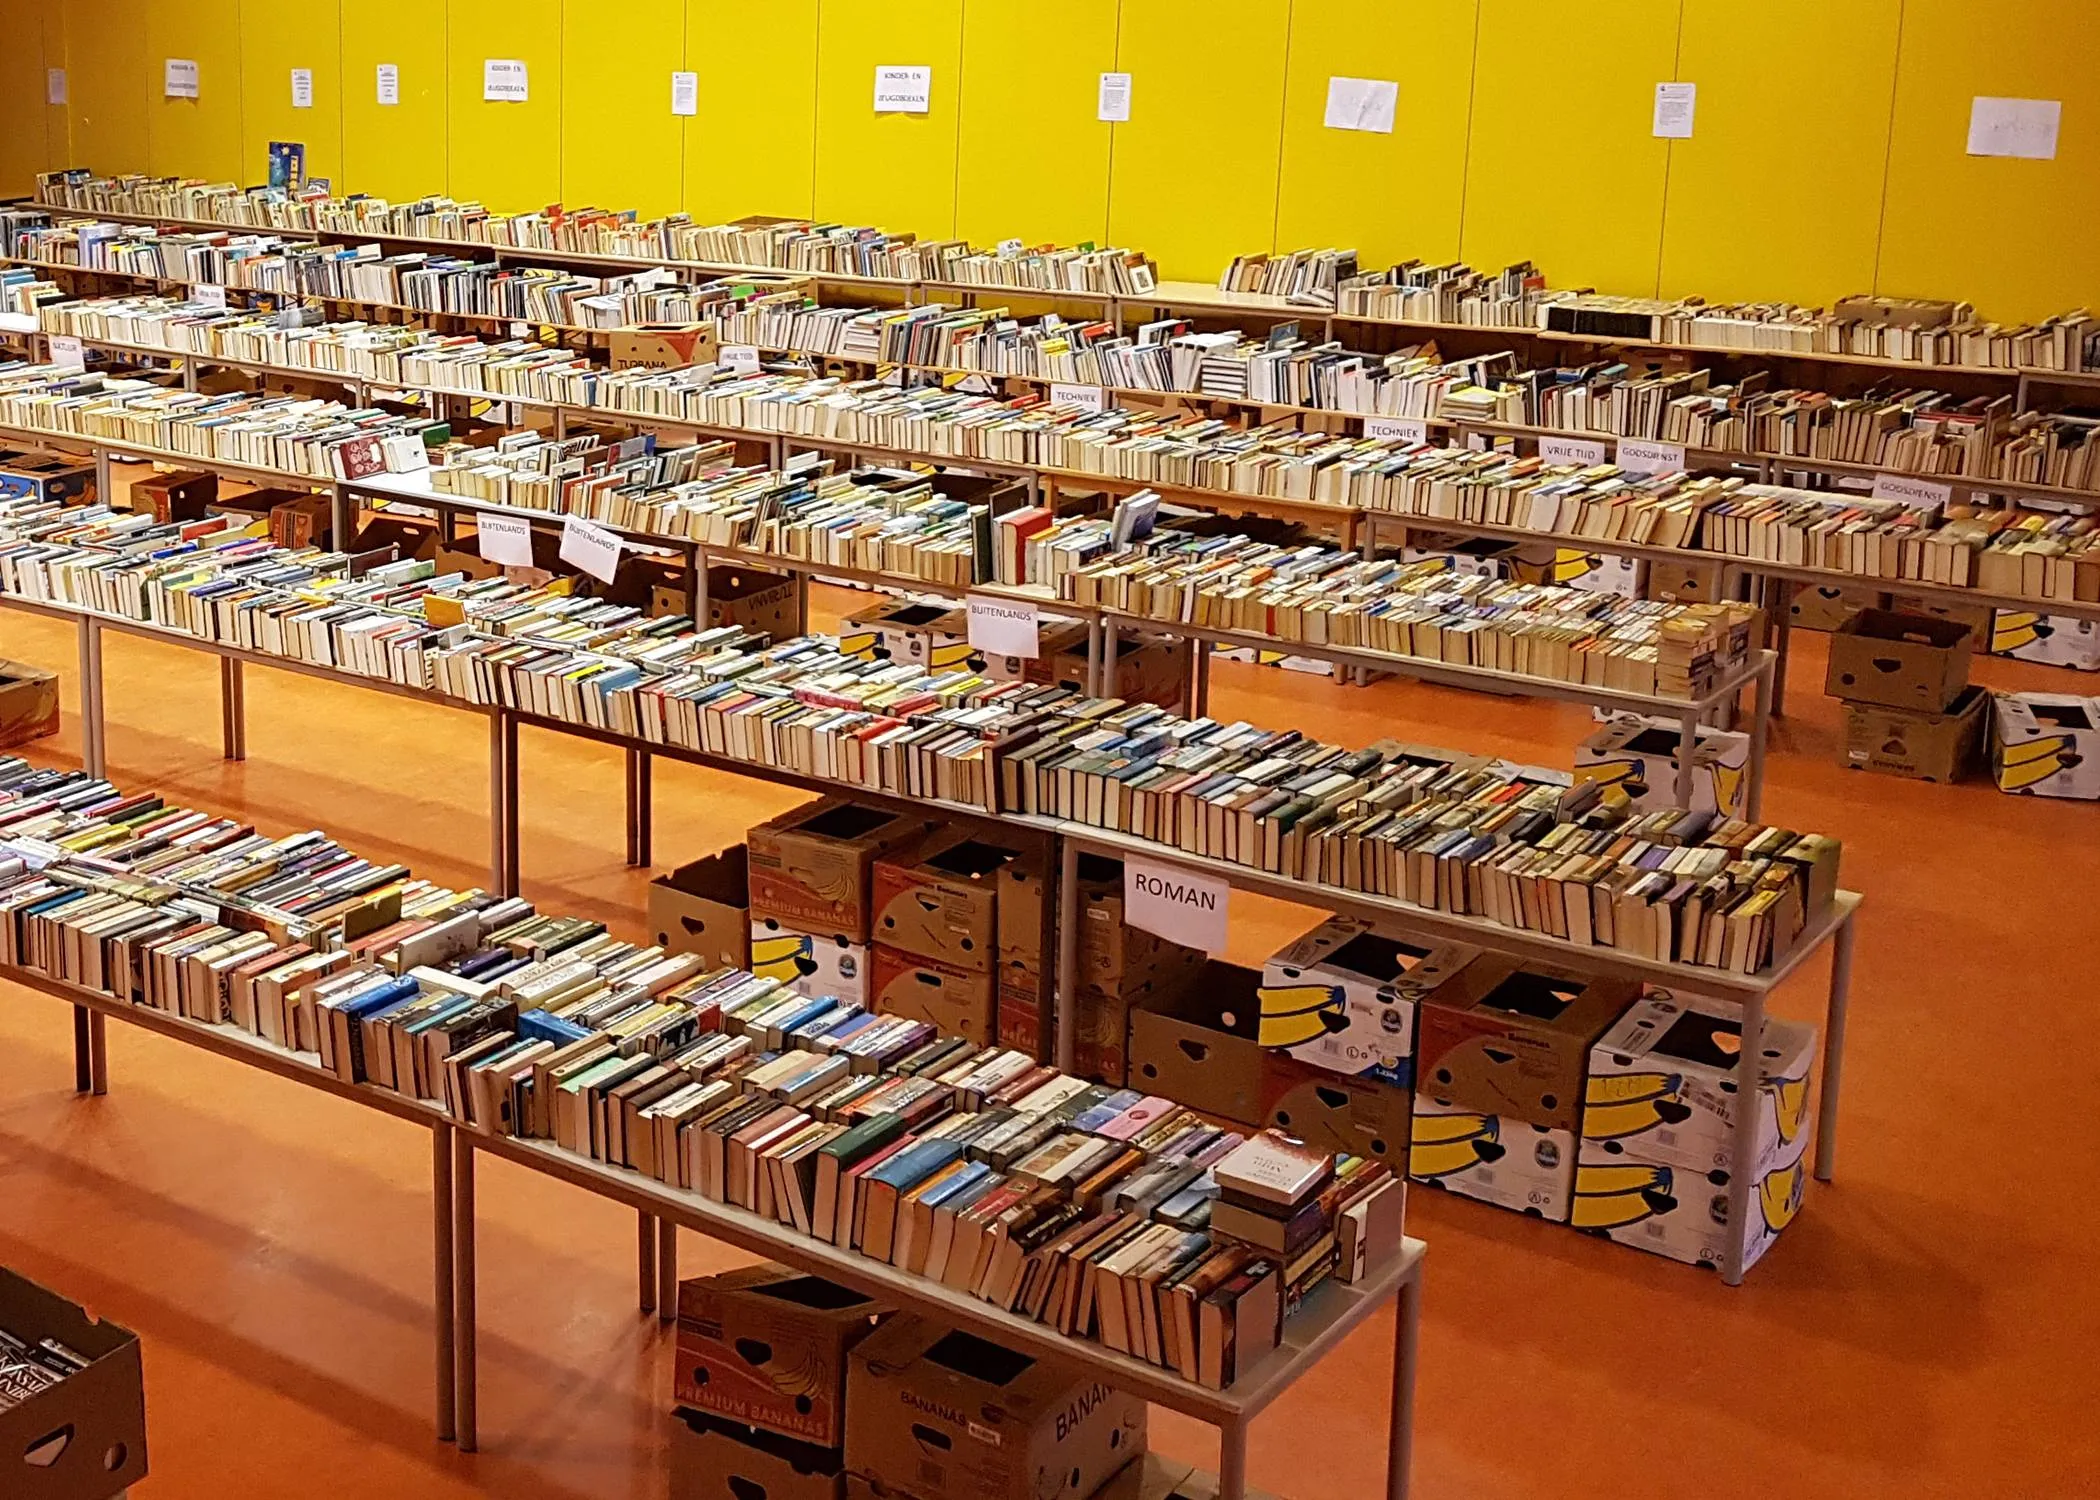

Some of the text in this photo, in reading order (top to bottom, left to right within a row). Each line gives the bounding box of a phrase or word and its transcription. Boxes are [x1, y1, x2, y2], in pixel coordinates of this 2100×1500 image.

[1056, 391, 1097, 403] TECHNIEK
[1371, 425, 1418, 438] TECHNIEK
[1547, 446, 1572, 456] VRIJE
[481, 521, 526, 535] BUITENLANDS
[569, 523, 616, 551] BUITENLANDS
[971, 605, 1031, 621] BUITENLANDS
[1135, 873, 1216, 911] ROMAN
[900, 1391, 967, 1427] BANANAS
[751, 1406, 825, 1436] BANANAS
